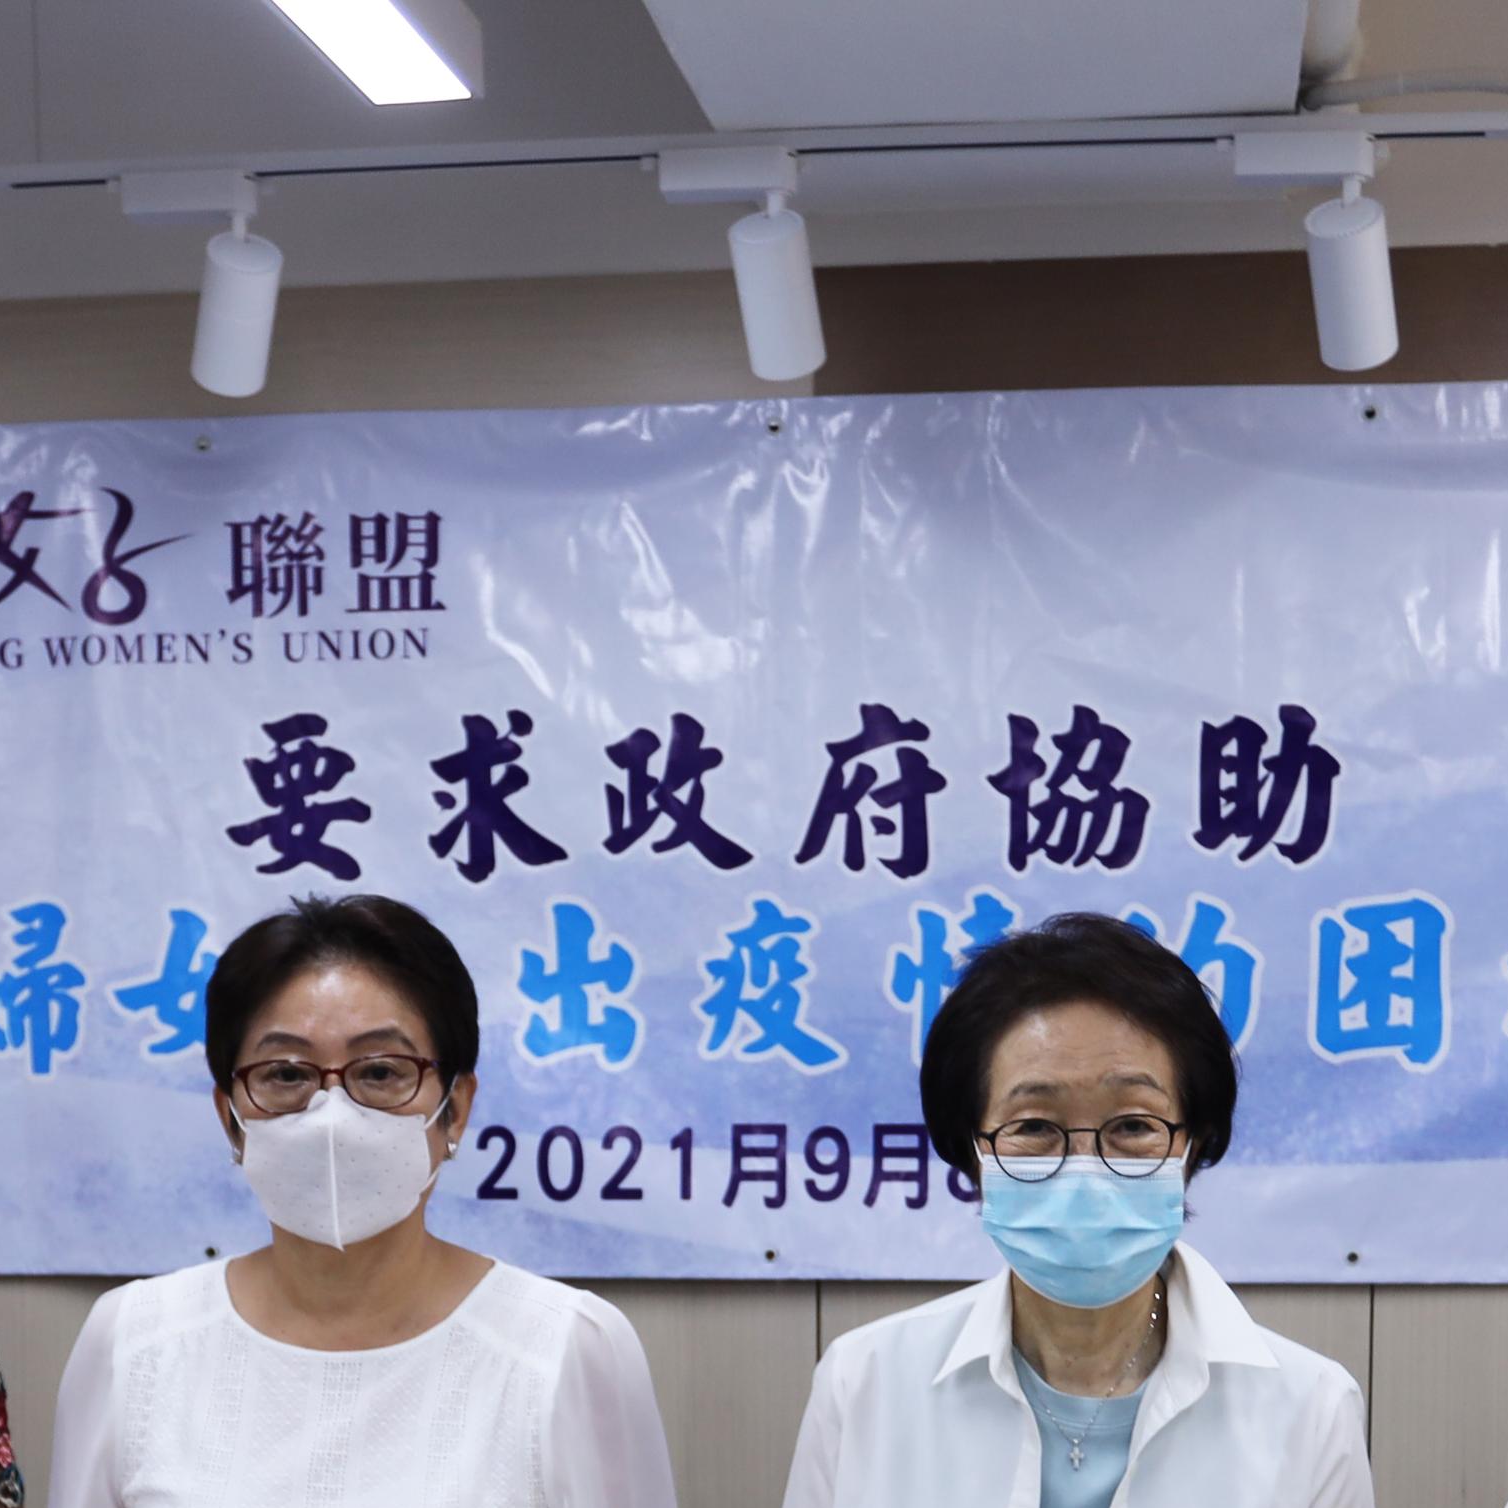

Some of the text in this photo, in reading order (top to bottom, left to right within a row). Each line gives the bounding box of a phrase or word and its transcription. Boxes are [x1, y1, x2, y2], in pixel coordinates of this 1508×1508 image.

[42, 628, 254, 668] WOMEN'S
[283, 626, 431, 662] UNION
[226, 703, 1341, 883] 要求政府協助
[476, 1123, 979, 1210] 2021月9月
